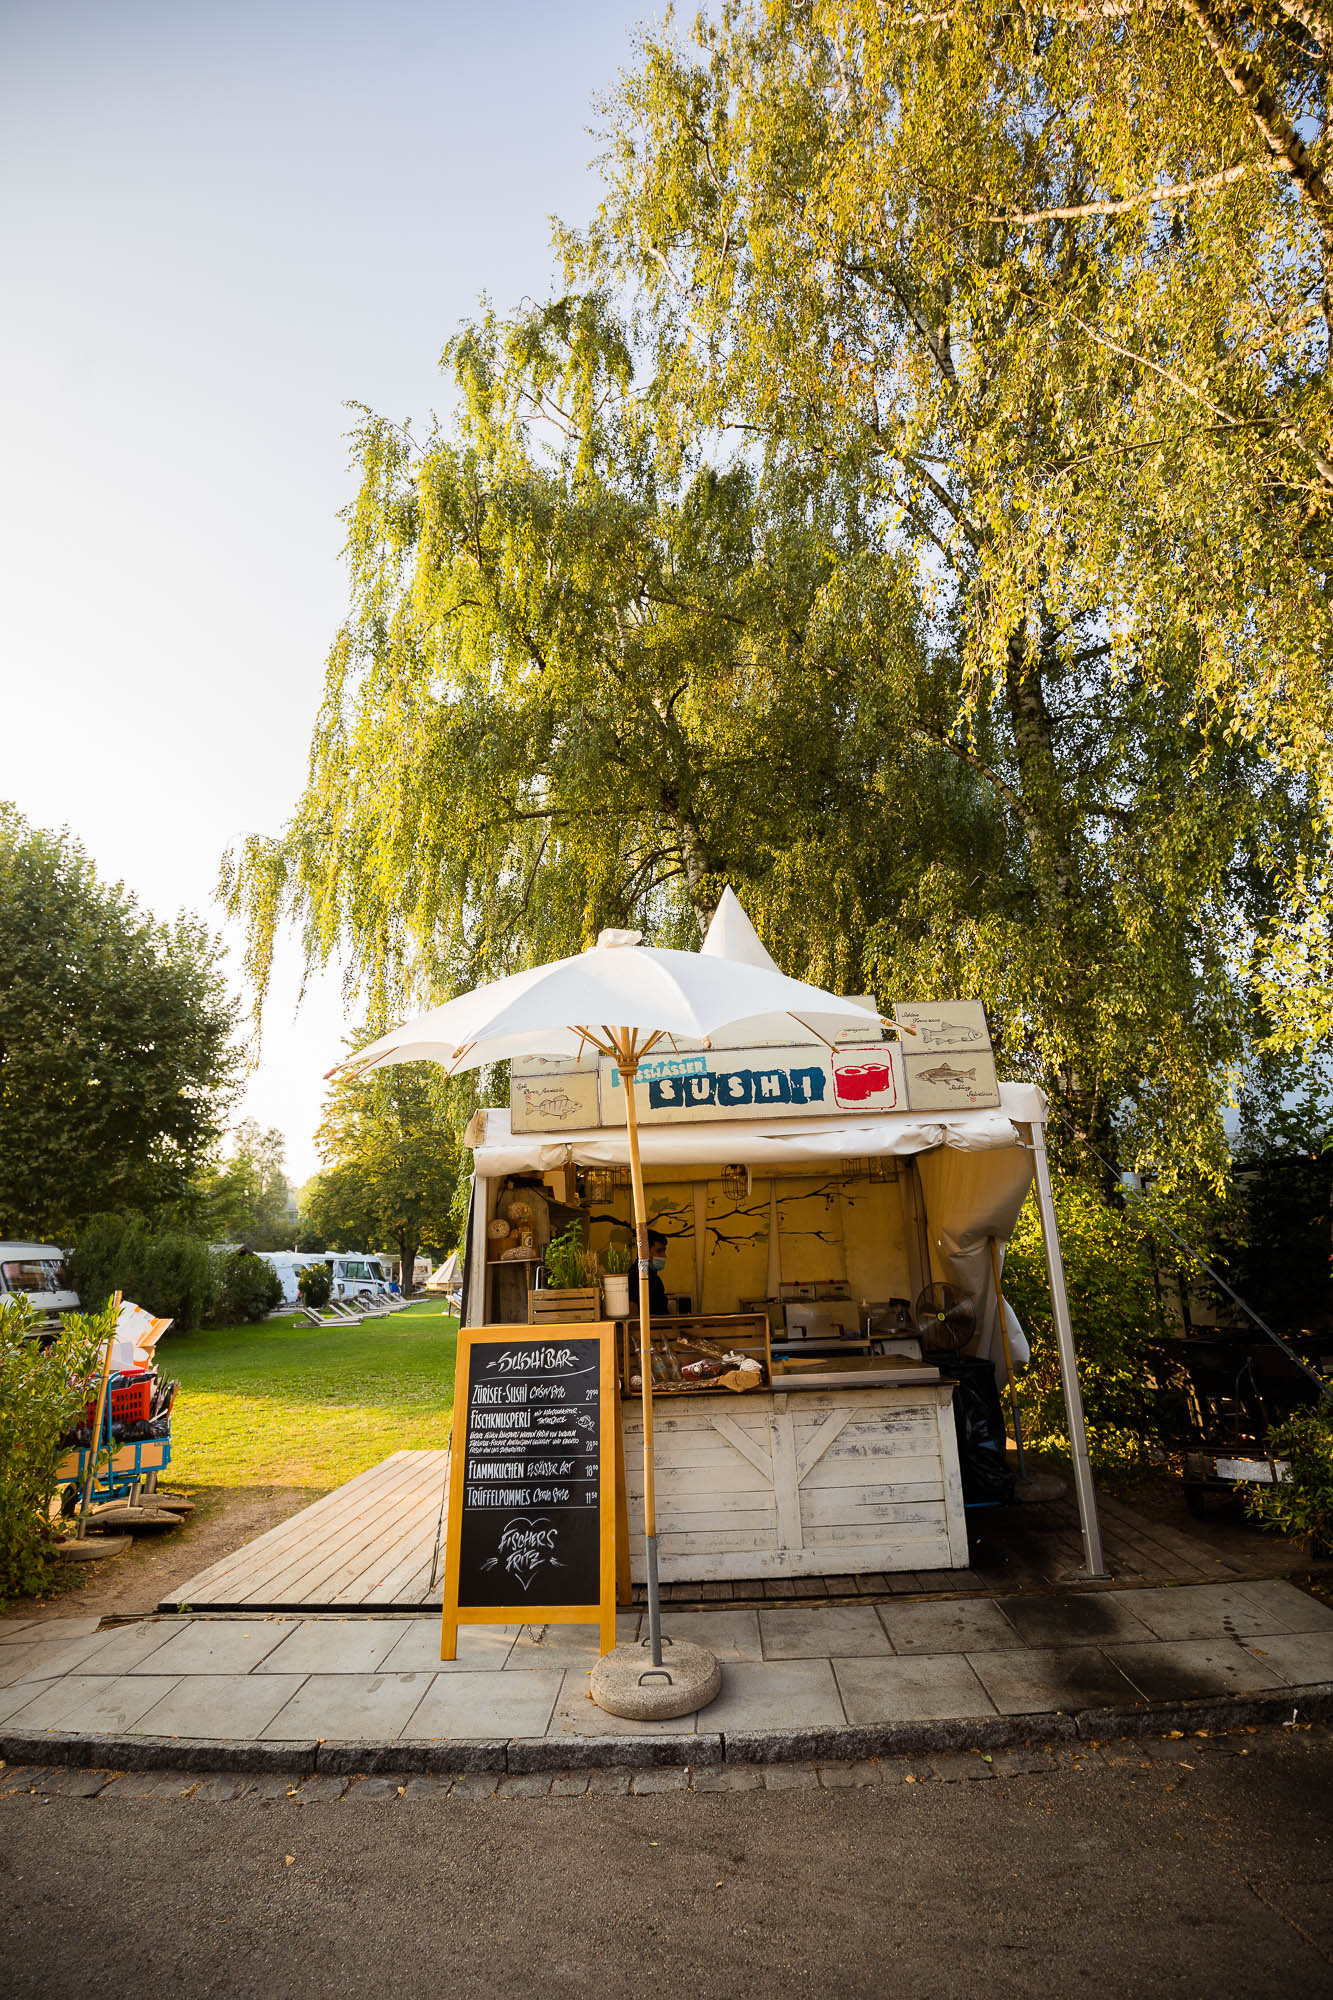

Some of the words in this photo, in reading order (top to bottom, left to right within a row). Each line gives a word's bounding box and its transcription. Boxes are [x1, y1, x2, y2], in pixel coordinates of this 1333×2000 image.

[659, 1075, 812, 1101] SUSHI
[468, 1460, 525, 1480] FLAMMKUCHEN
[466, 1486, 531, 1507] TRÜFFELPOMMES
[497, 1528, 558, 1554] FISCHERS
